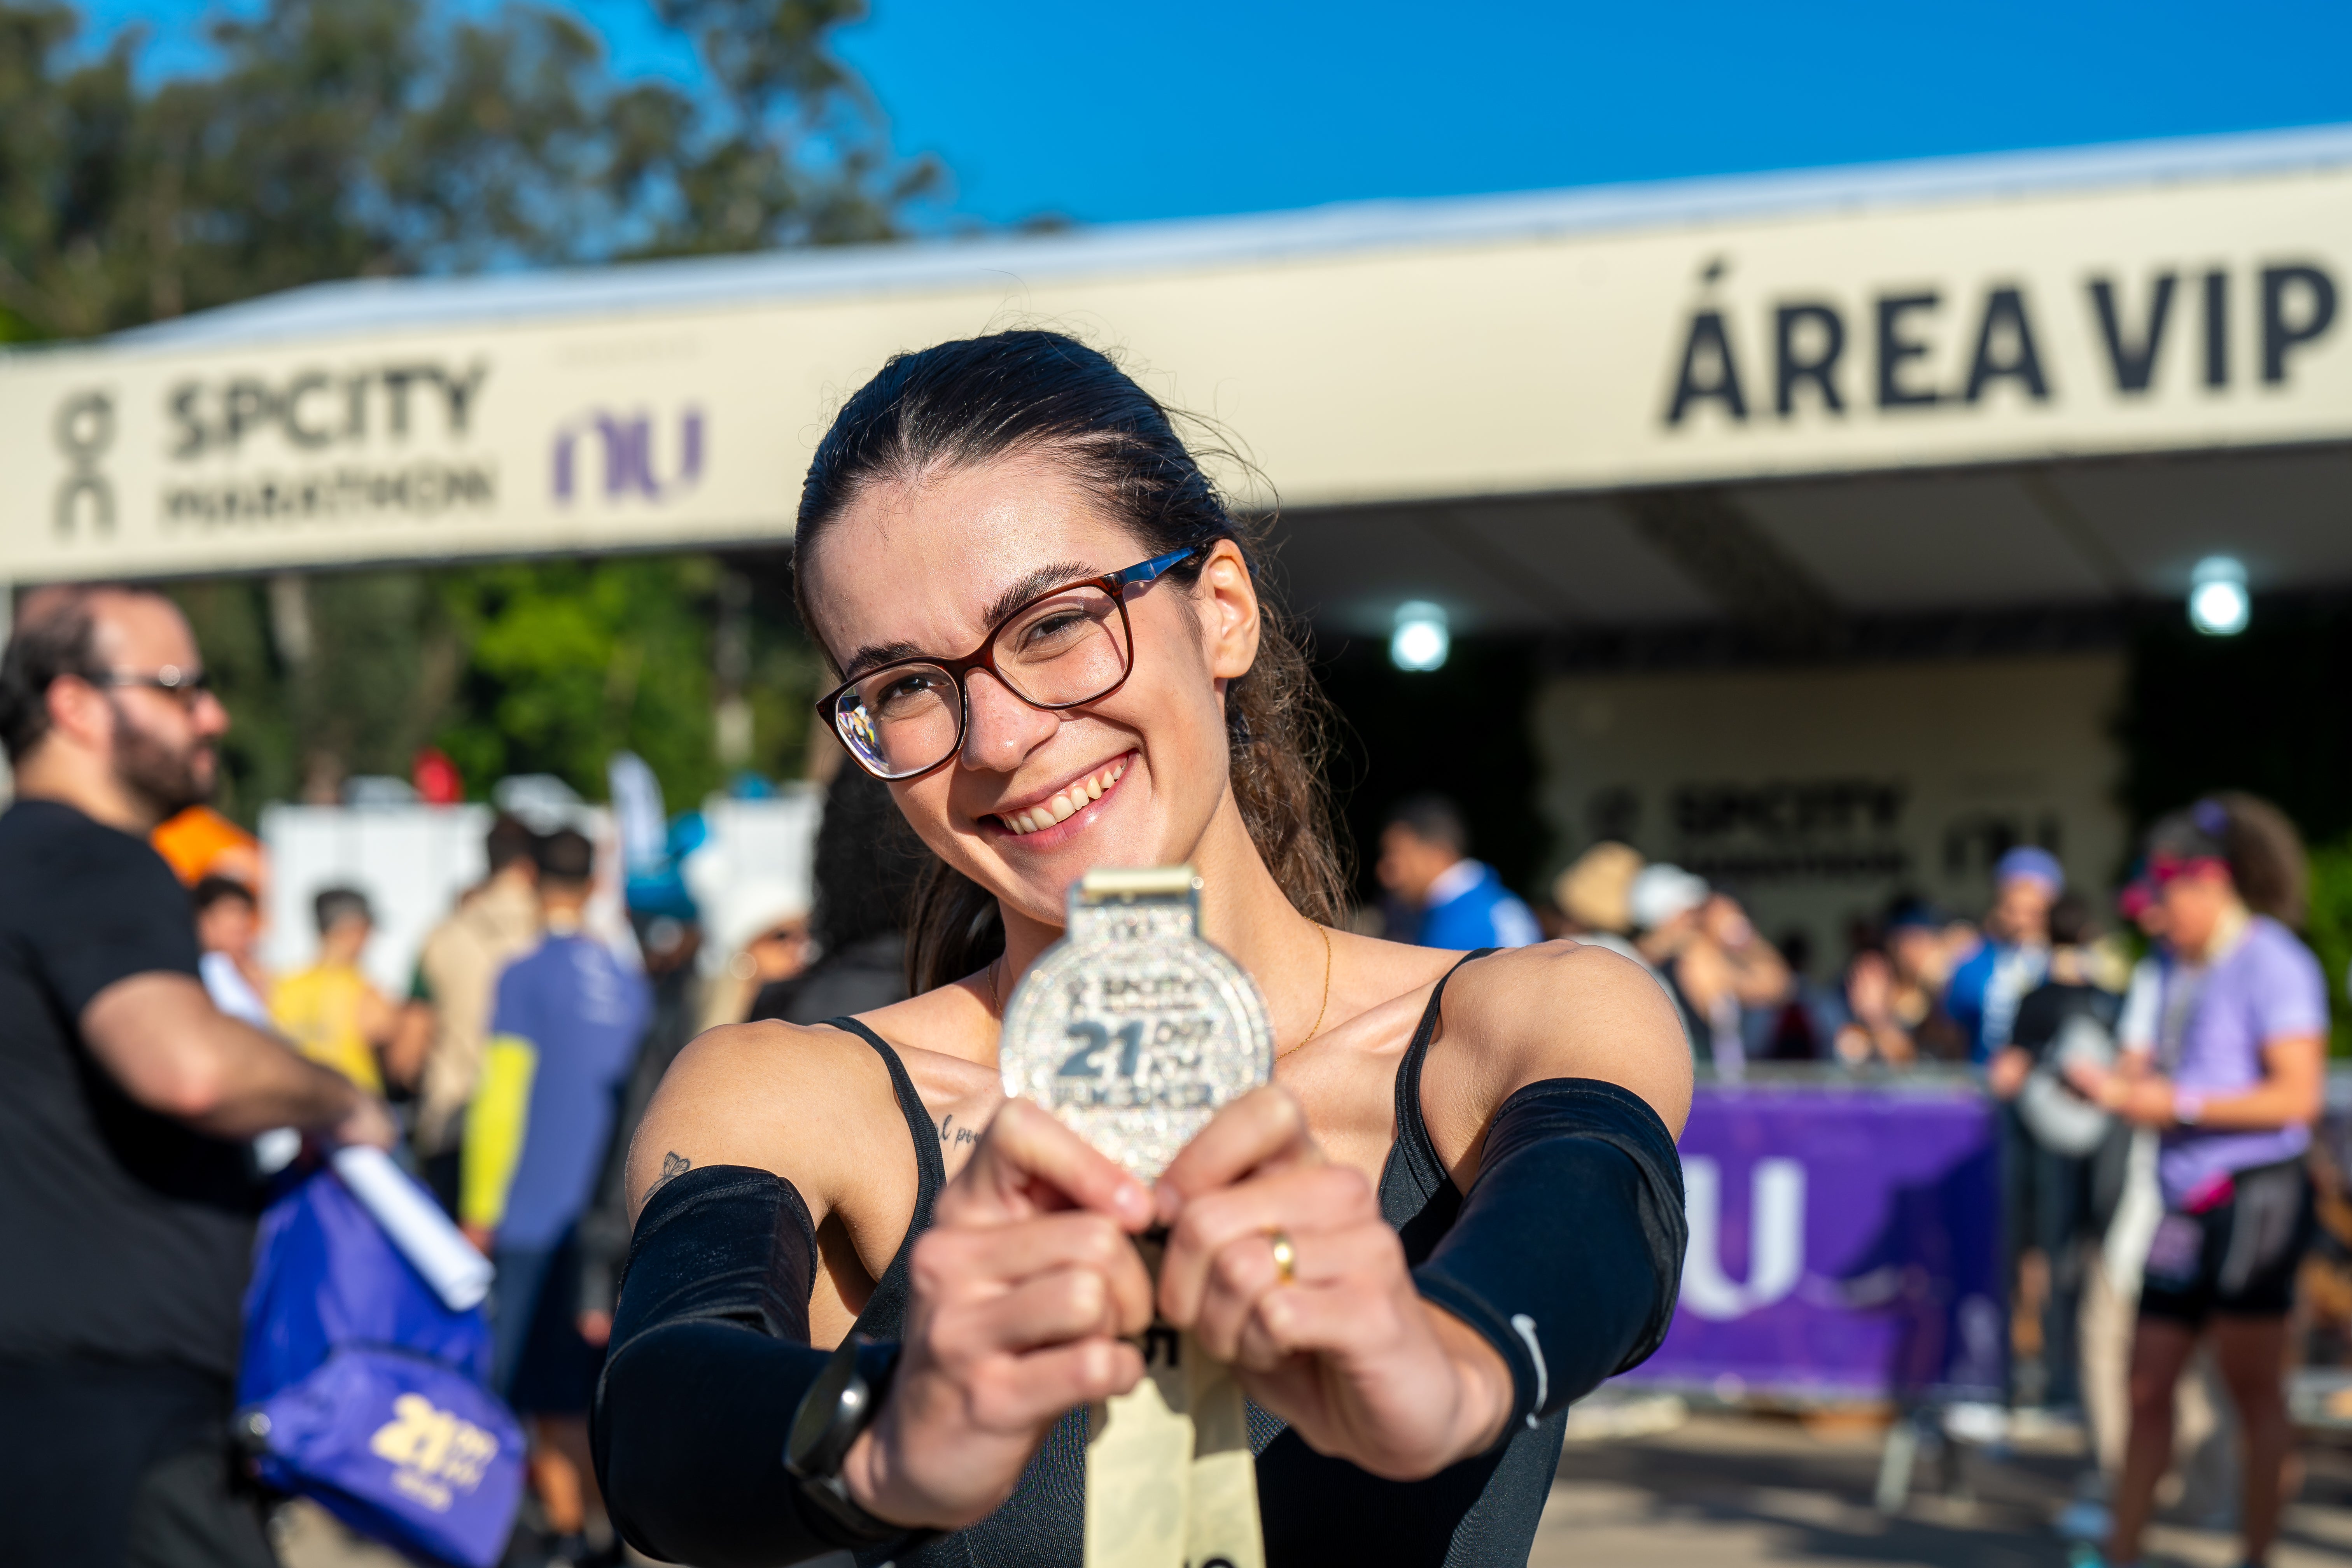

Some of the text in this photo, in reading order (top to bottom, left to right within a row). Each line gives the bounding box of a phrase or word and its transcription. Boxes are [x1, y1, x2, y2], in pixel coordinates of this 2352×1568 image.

[1662, 257, 2339, 429] ÁREA VIP
[1057, 1021, 1144, 1076] 21
